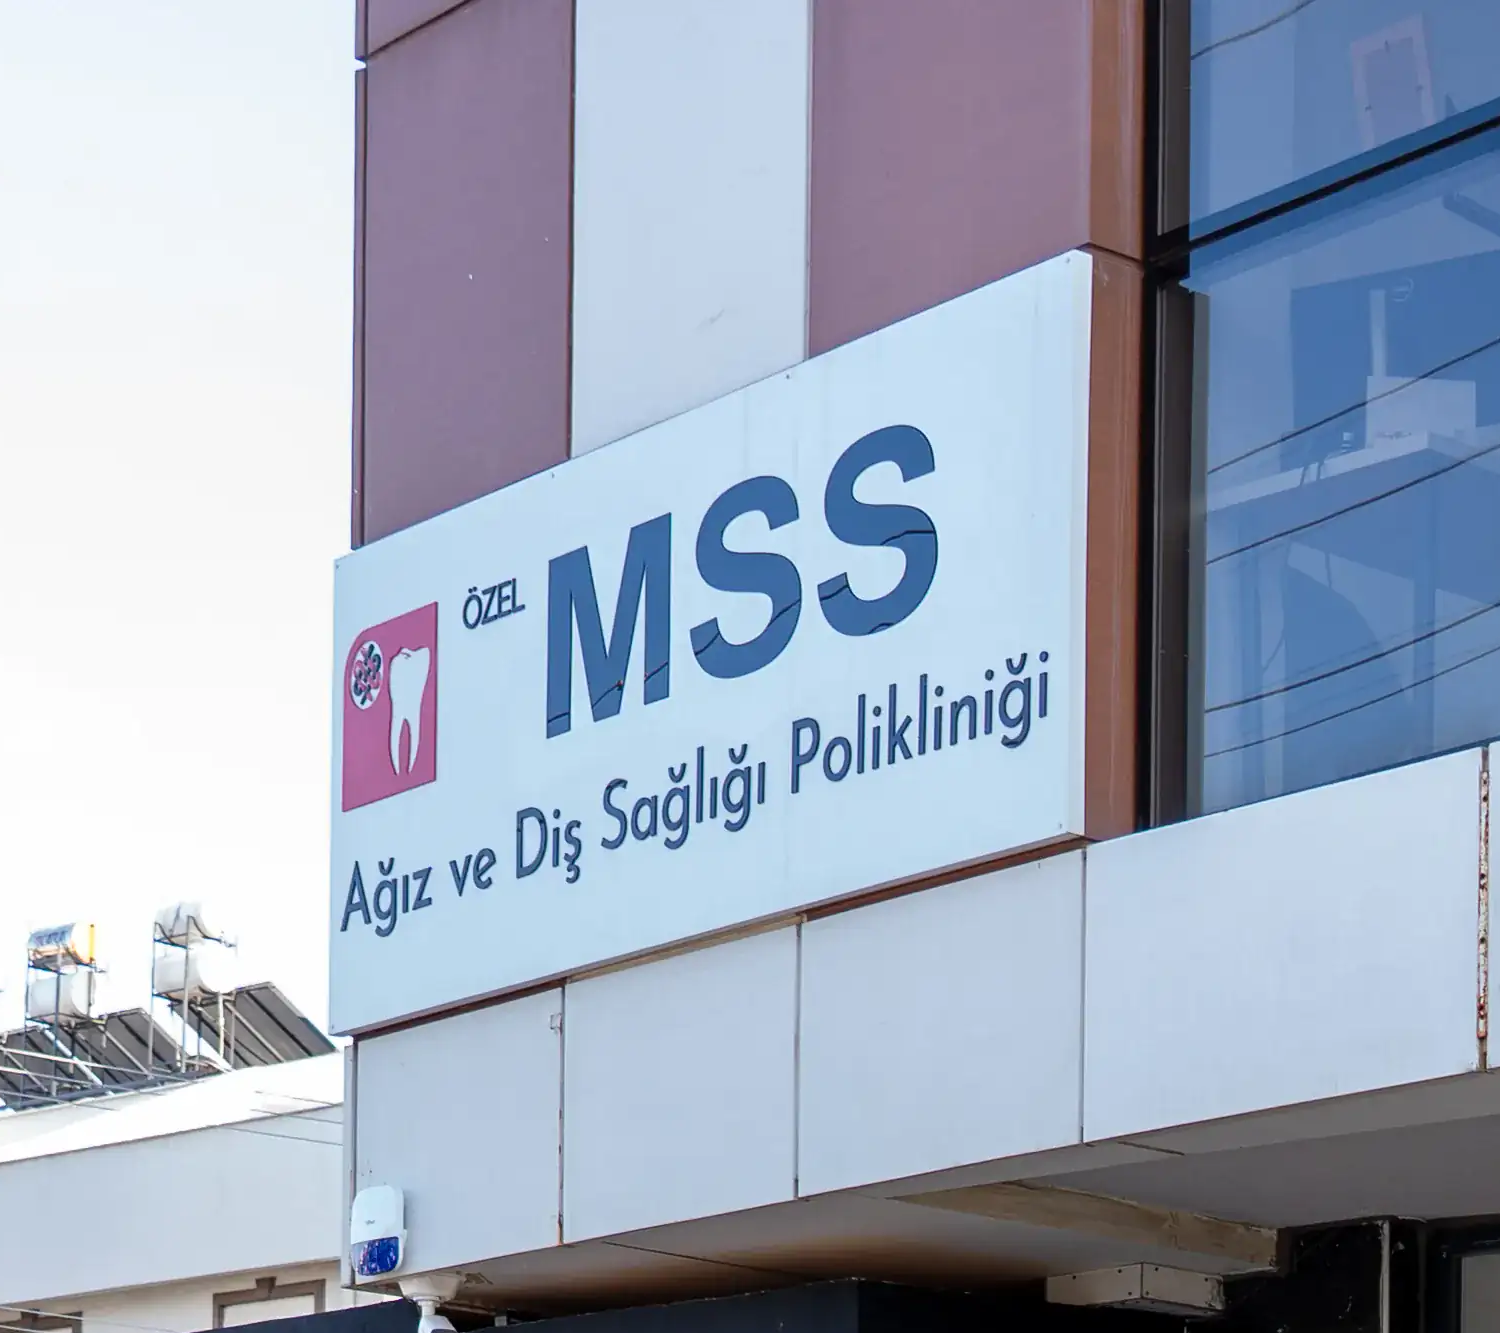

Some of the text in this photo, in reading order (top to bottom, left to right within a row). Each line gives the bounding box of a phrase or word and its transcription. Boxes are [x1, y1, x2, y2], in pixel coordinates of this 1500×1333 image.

[461, 424, 939, 739] ÖZEL MSS
[339, 650, 1051, 938] Ağız ve Diş Sağlığı Polikliniği
